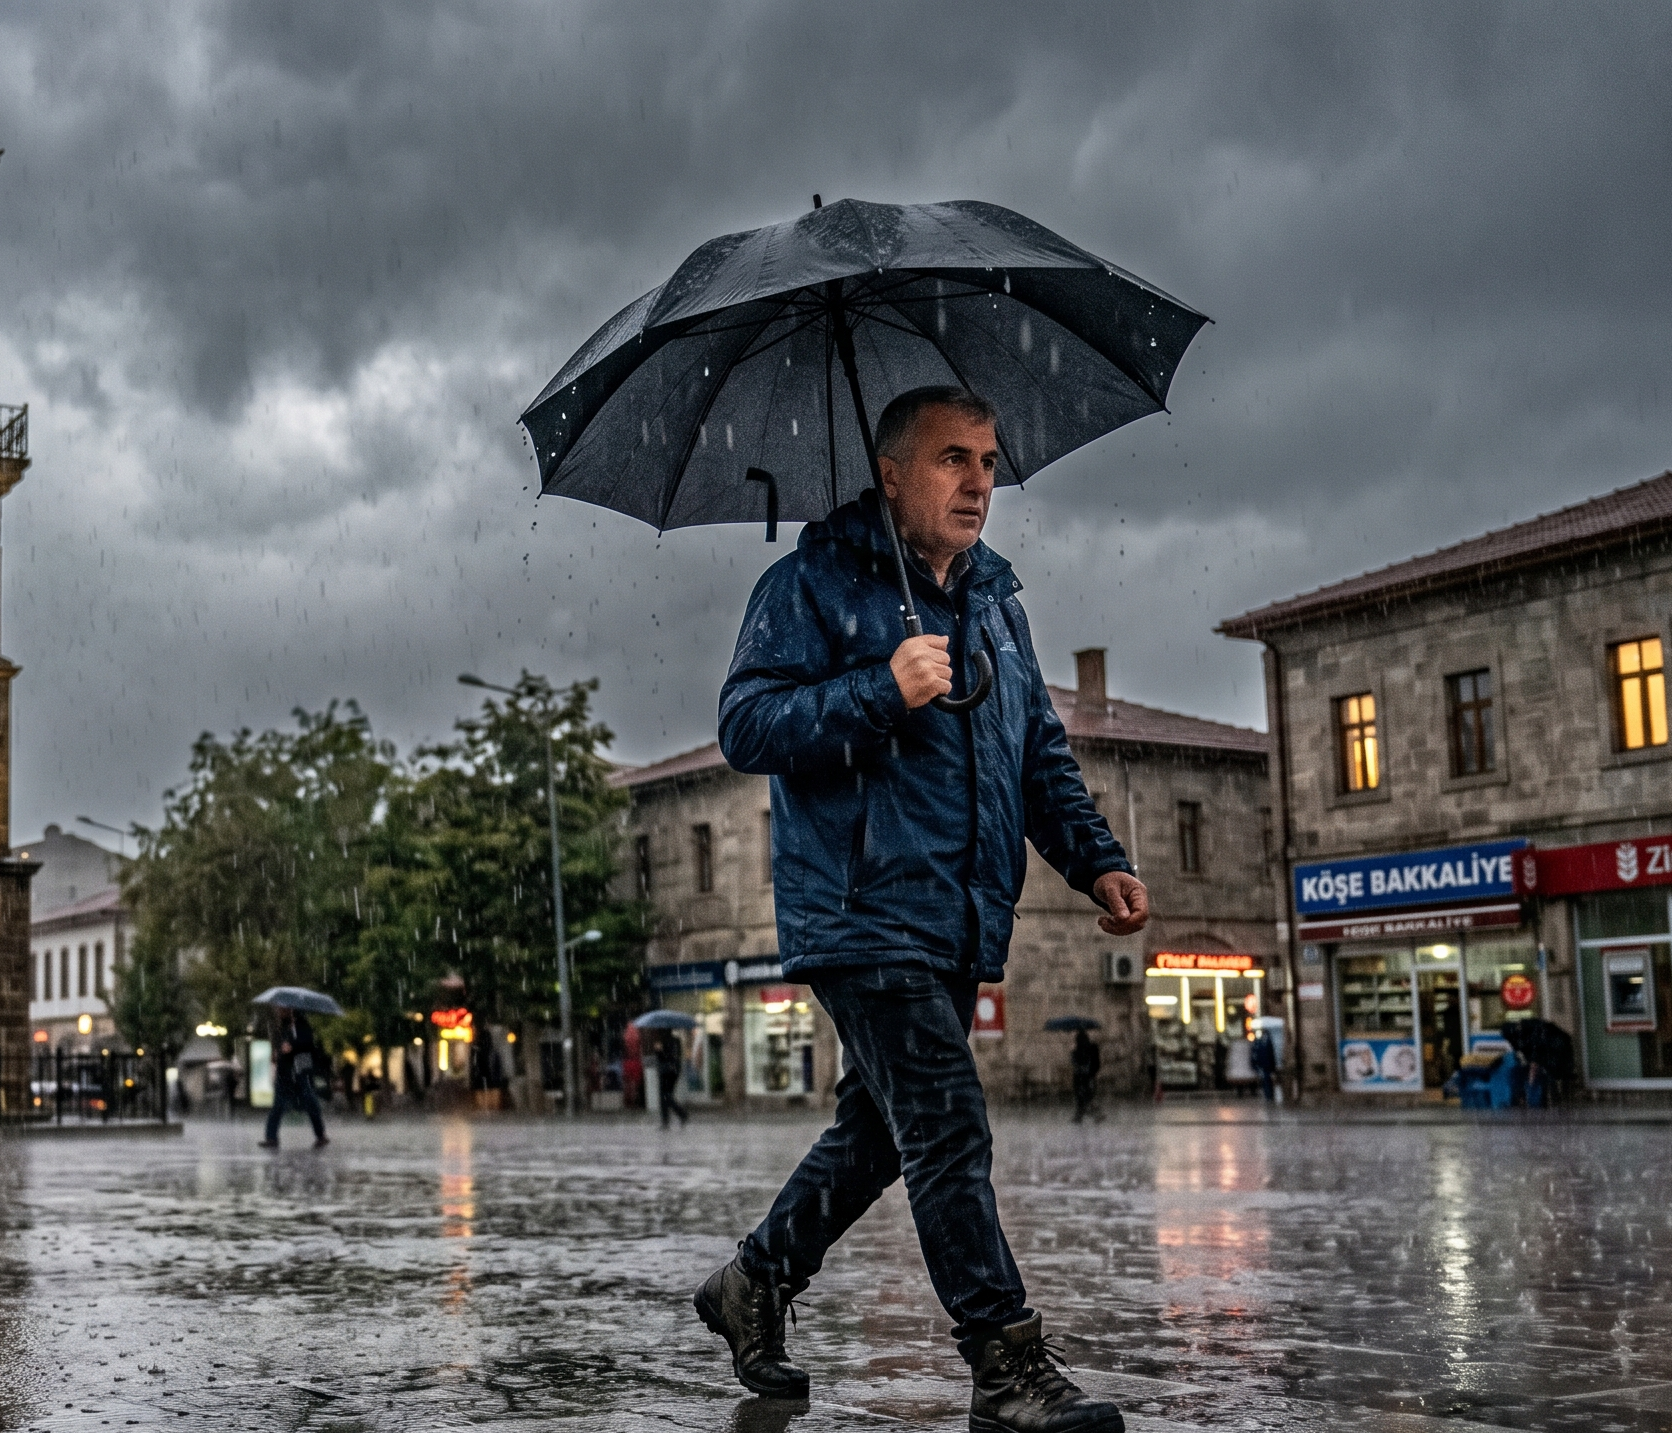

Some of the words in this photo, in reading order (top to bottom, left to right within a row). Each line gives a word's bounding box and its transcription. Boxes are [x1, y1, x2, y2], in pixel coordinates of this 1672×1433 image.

[1302, 860, 1364, 906] KÖŞE
[1369, 852, 1512, 896] BAKKALİYE
[1645, 844, 1672, 875] ZI
